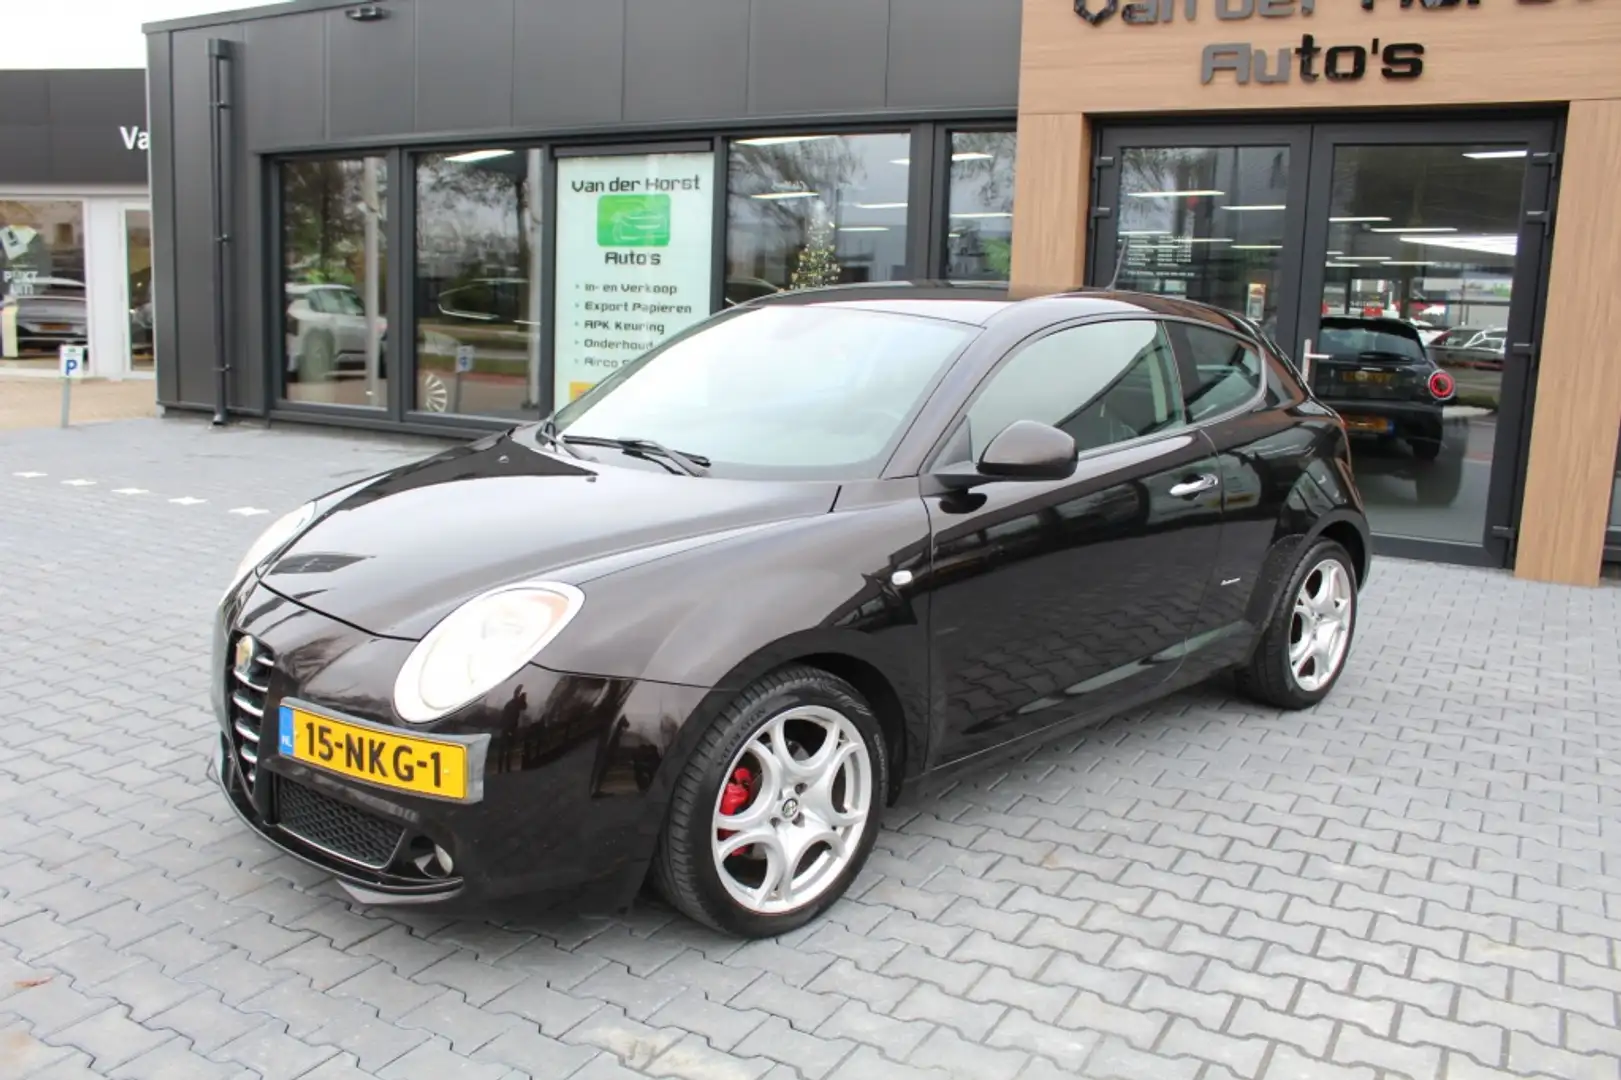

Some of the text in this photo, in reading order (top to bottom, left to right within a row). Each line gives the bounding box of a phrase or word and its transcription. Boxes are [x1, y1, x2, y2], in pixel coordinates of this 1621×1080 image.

[1201, 33, 1425, 85] Auto's
[571, 174, 700, 193] Van der Horst
[604, 250, 662, 266] Auto's
[603, 284, 618, 292] en
[620, 284, 678, 296] Verkoop
[584, 301, 693, 314] Export Papieren
[584, 320, 665, 335] APK Keuring
[65, 360, 77, 376] P
[584, 357, 619, 368] Airco
[281, 735, 293, 748] NL
[305, 721, 442, 788] 15-NKG-1
